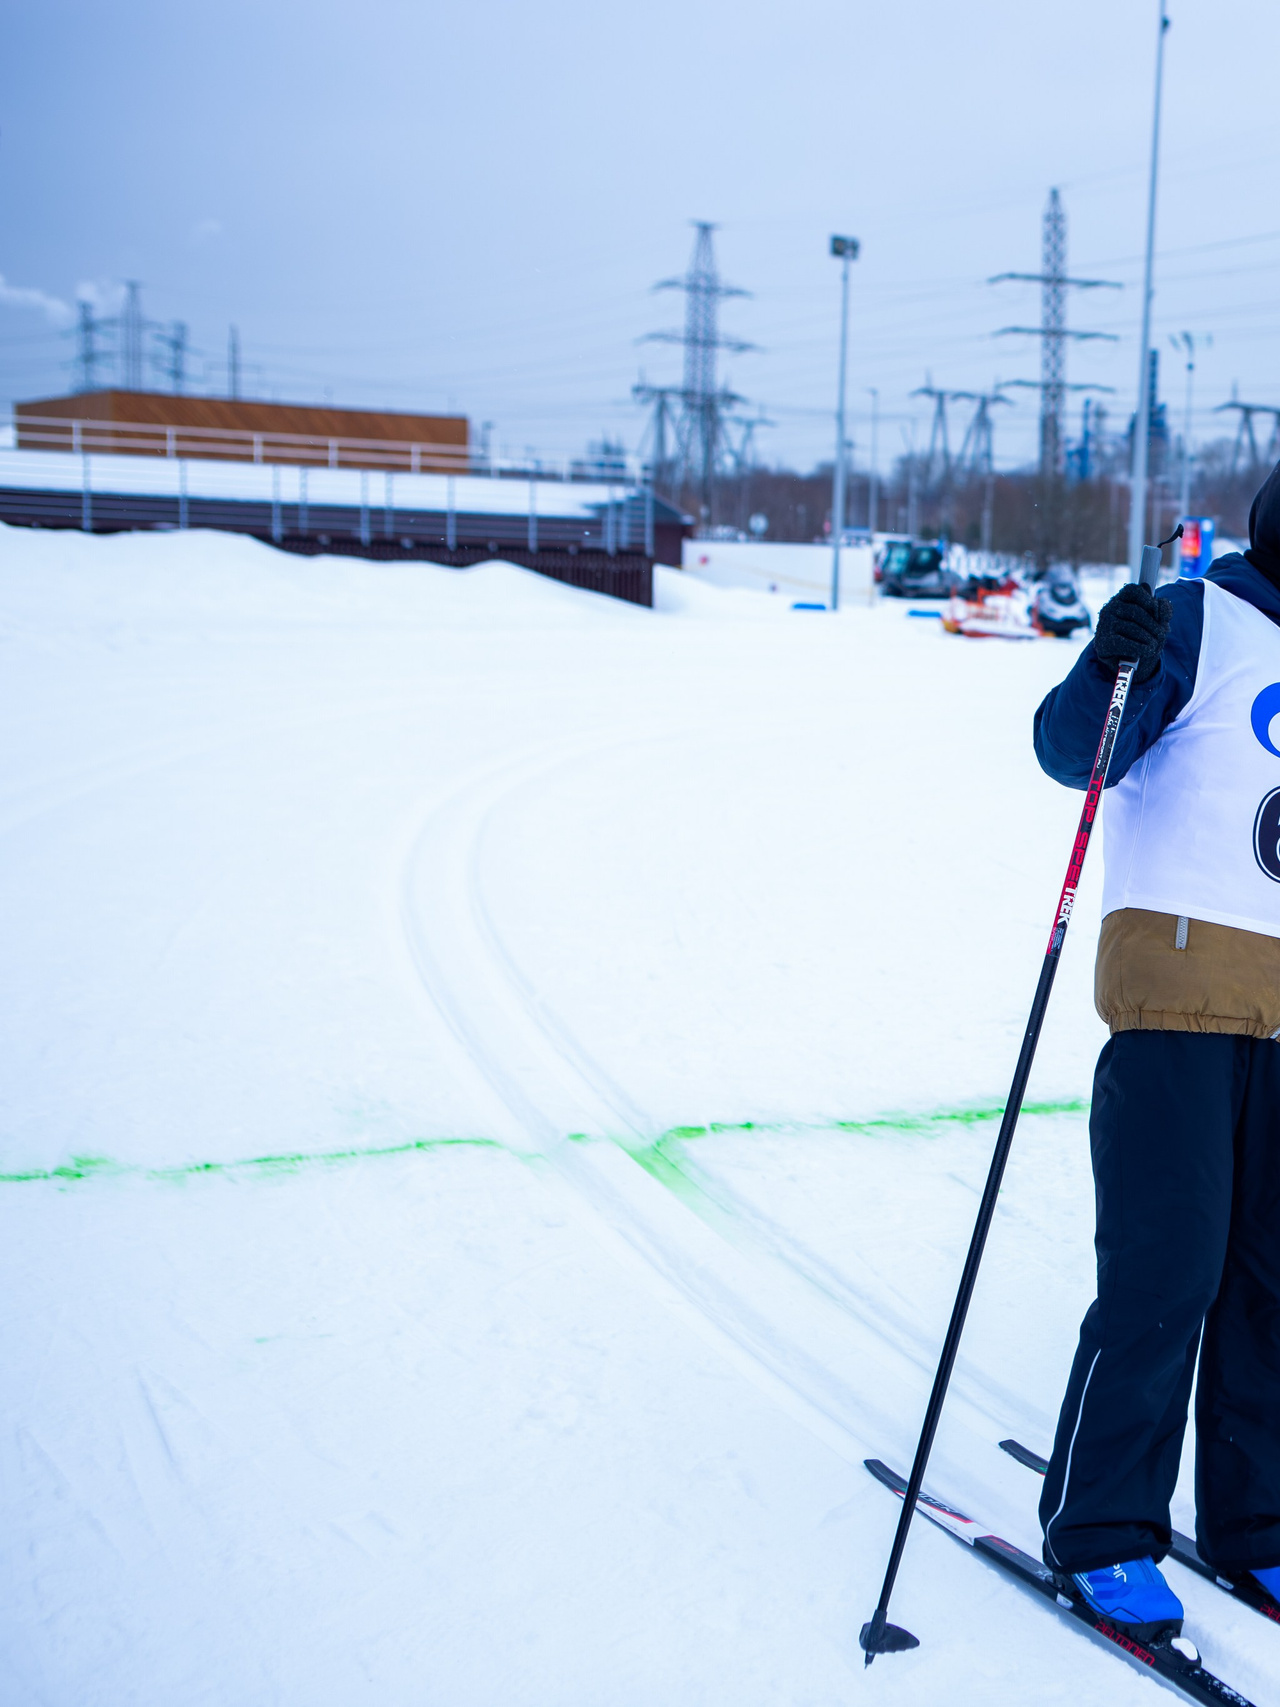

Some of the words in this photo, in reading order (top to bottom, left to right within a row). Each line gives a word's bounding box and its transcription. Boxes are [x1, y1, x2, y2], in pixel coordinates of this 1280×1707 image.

[1109, 670, 1132, 712] TREK
[1085, 775, 1104, 823] TOP
[1065, 831, 1089, 890] SPEE
[1056, 886, 1079, 927] TREK
[1094, 1621, 1156, 1667] PELTONEN
